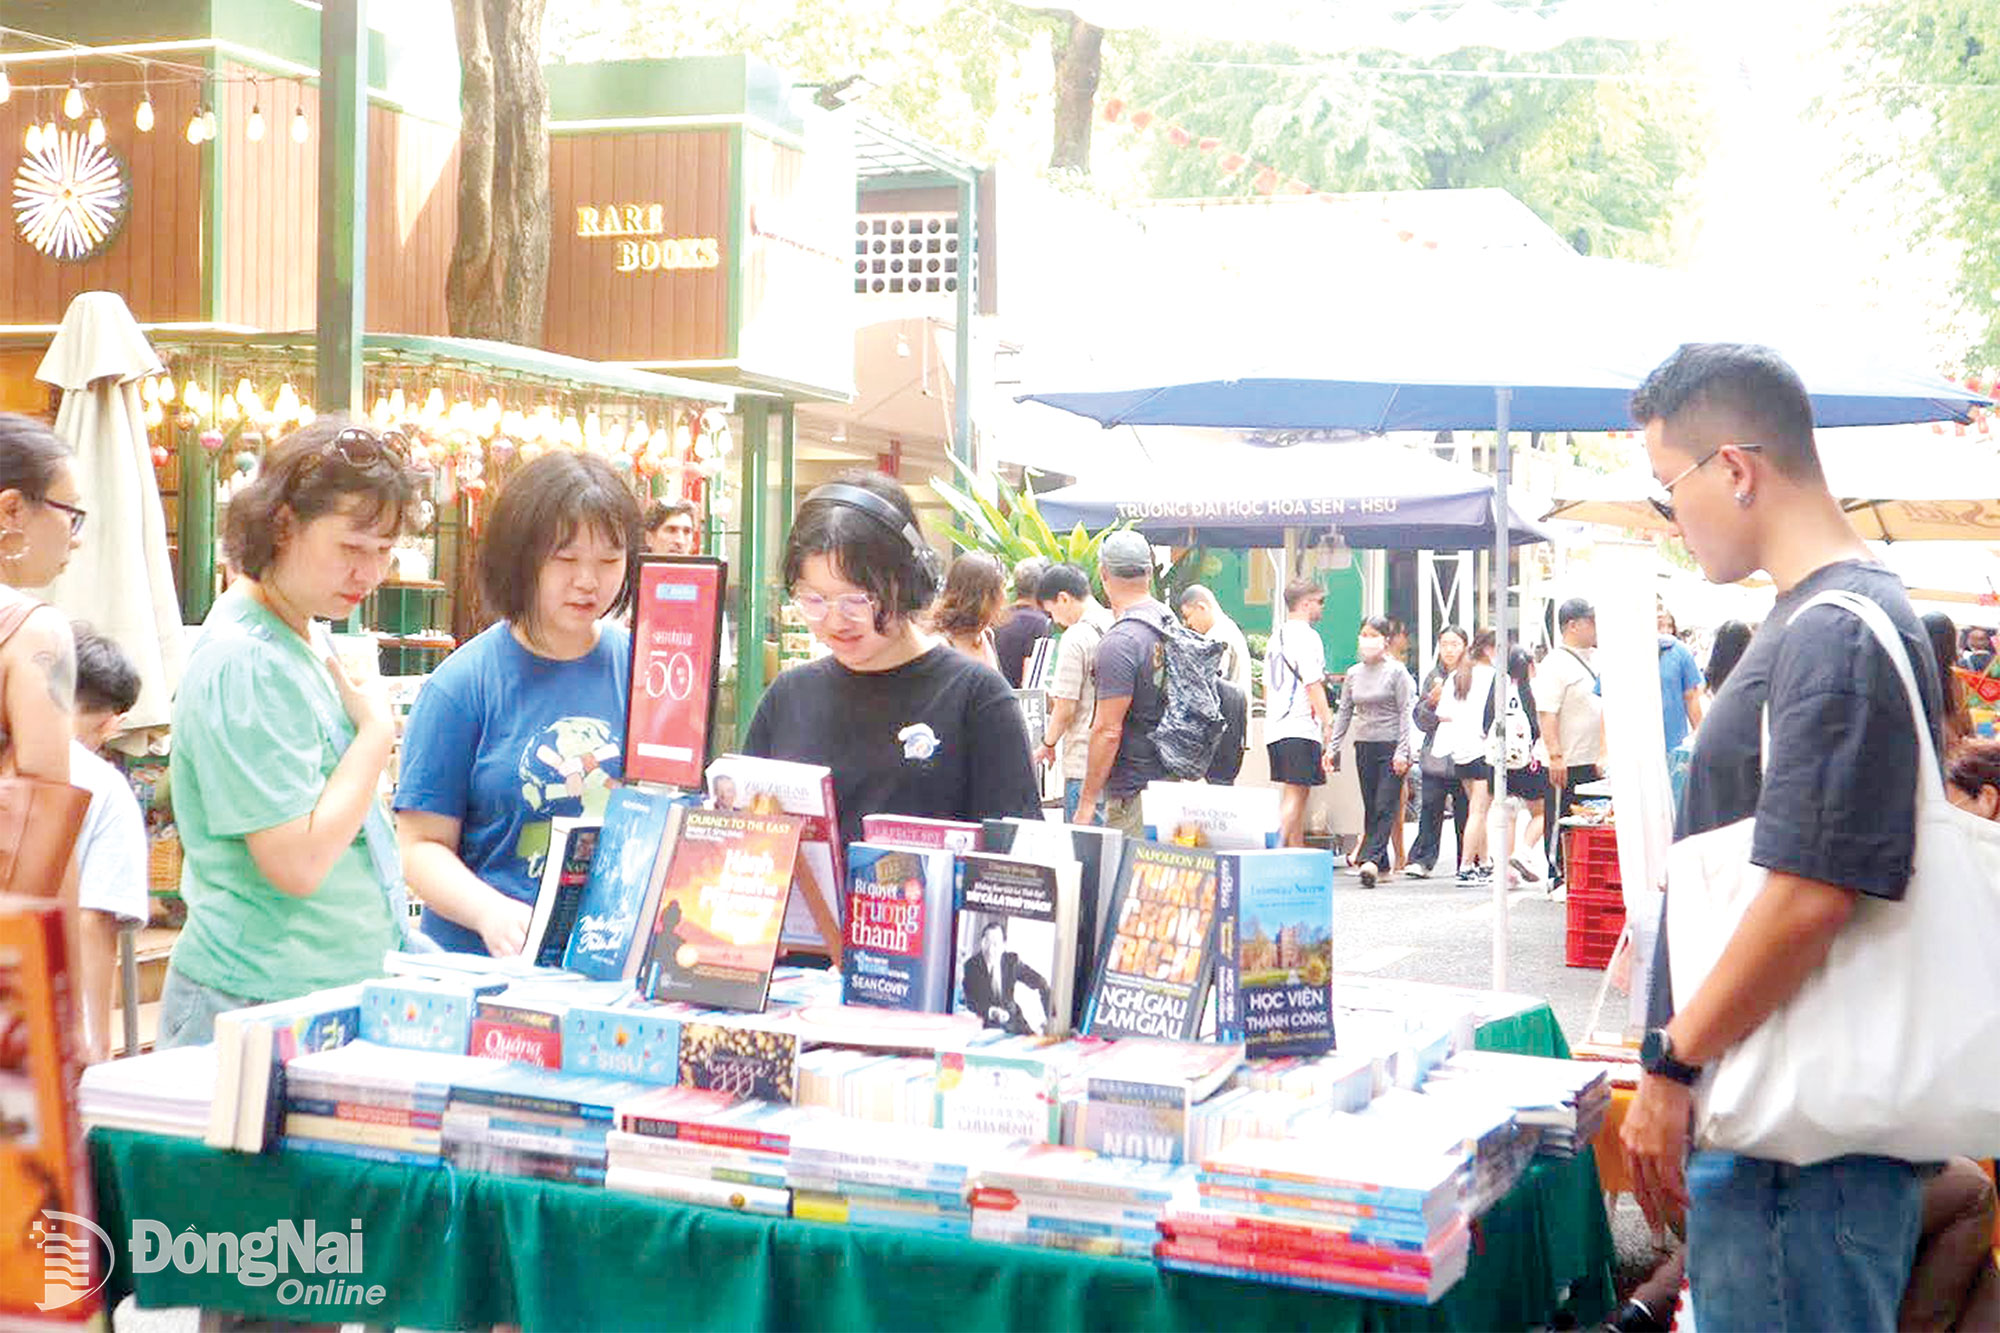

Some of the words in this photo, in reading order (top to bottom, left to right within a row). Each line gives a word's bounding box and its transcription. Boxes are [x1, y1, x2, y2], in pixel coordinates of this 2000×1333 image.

[616, 238, 720, 271] BOOKS
[1268, 499, 1308, 517] HOA
[1310, 499, 1345, 515] SEN
[1361, 498, 1397, 513] HSU
[687, 813, 729, 828] JOURNEY
[731, 818, 746, 830] TO
[766, 822, 791, 834] EAST
[852, 974, 877, 991] SEAN
[878, 978, 909, 997] COVEY
[1250, 992, 1285, 1013] HỌC
[1103, 1131, 1174, 1160] NOW
